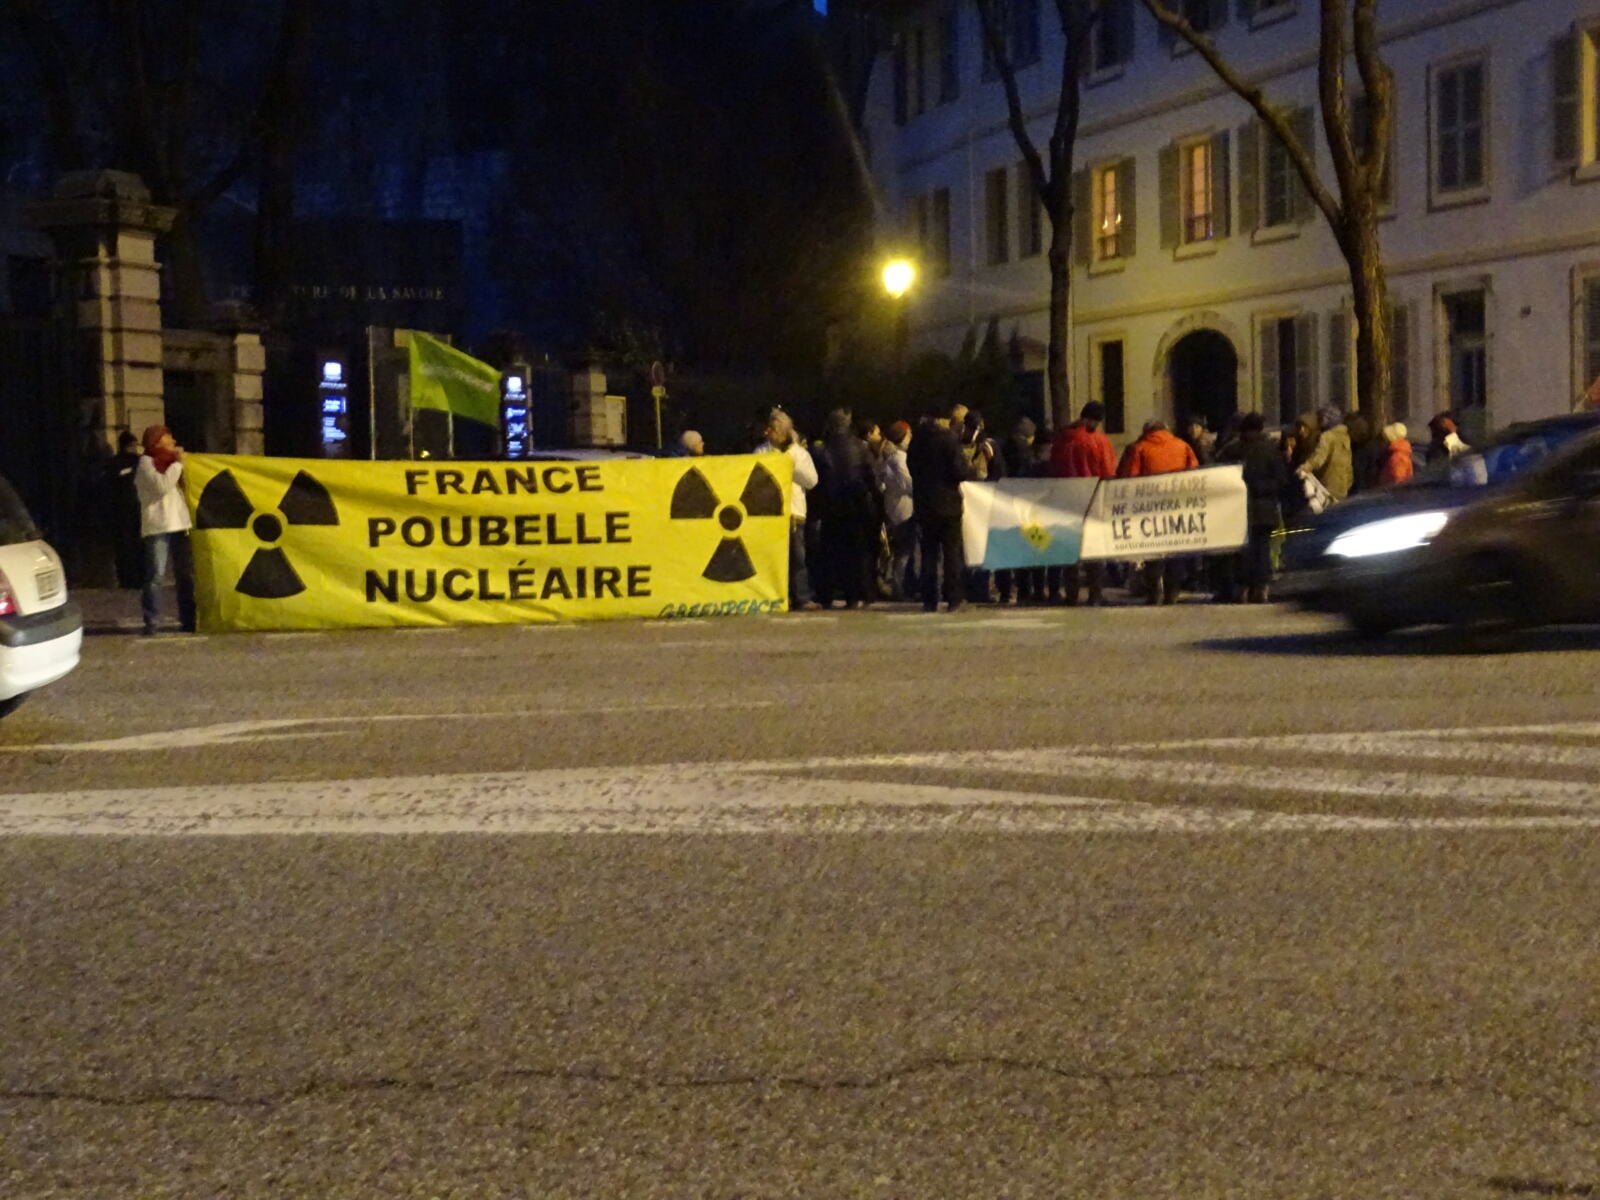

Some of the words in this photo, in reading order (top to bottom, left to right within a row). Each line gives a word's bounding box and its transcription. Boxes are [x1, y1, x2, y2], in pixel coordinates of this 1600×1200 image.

[404, 465, 604, 495] FRANCE
[1113, 484, 1129, 499] LE
[1136, 476, 1207, 497] NUCLÉAIRE
[1111, 502, 1128, 516] NE
[1132, 499, 1180, 513] SAUVERA
[1185, 495, 1207, 509] PAS
[367, 511, 632, 547] POUBELLE
[1112, 518, 1131, 540] LE
[1140, 512, 1207, 537] CLIMAT
[365, 559, 652, 602] NUCLÉAIRE
[657, 598, 785, 618] GREENPEACE
